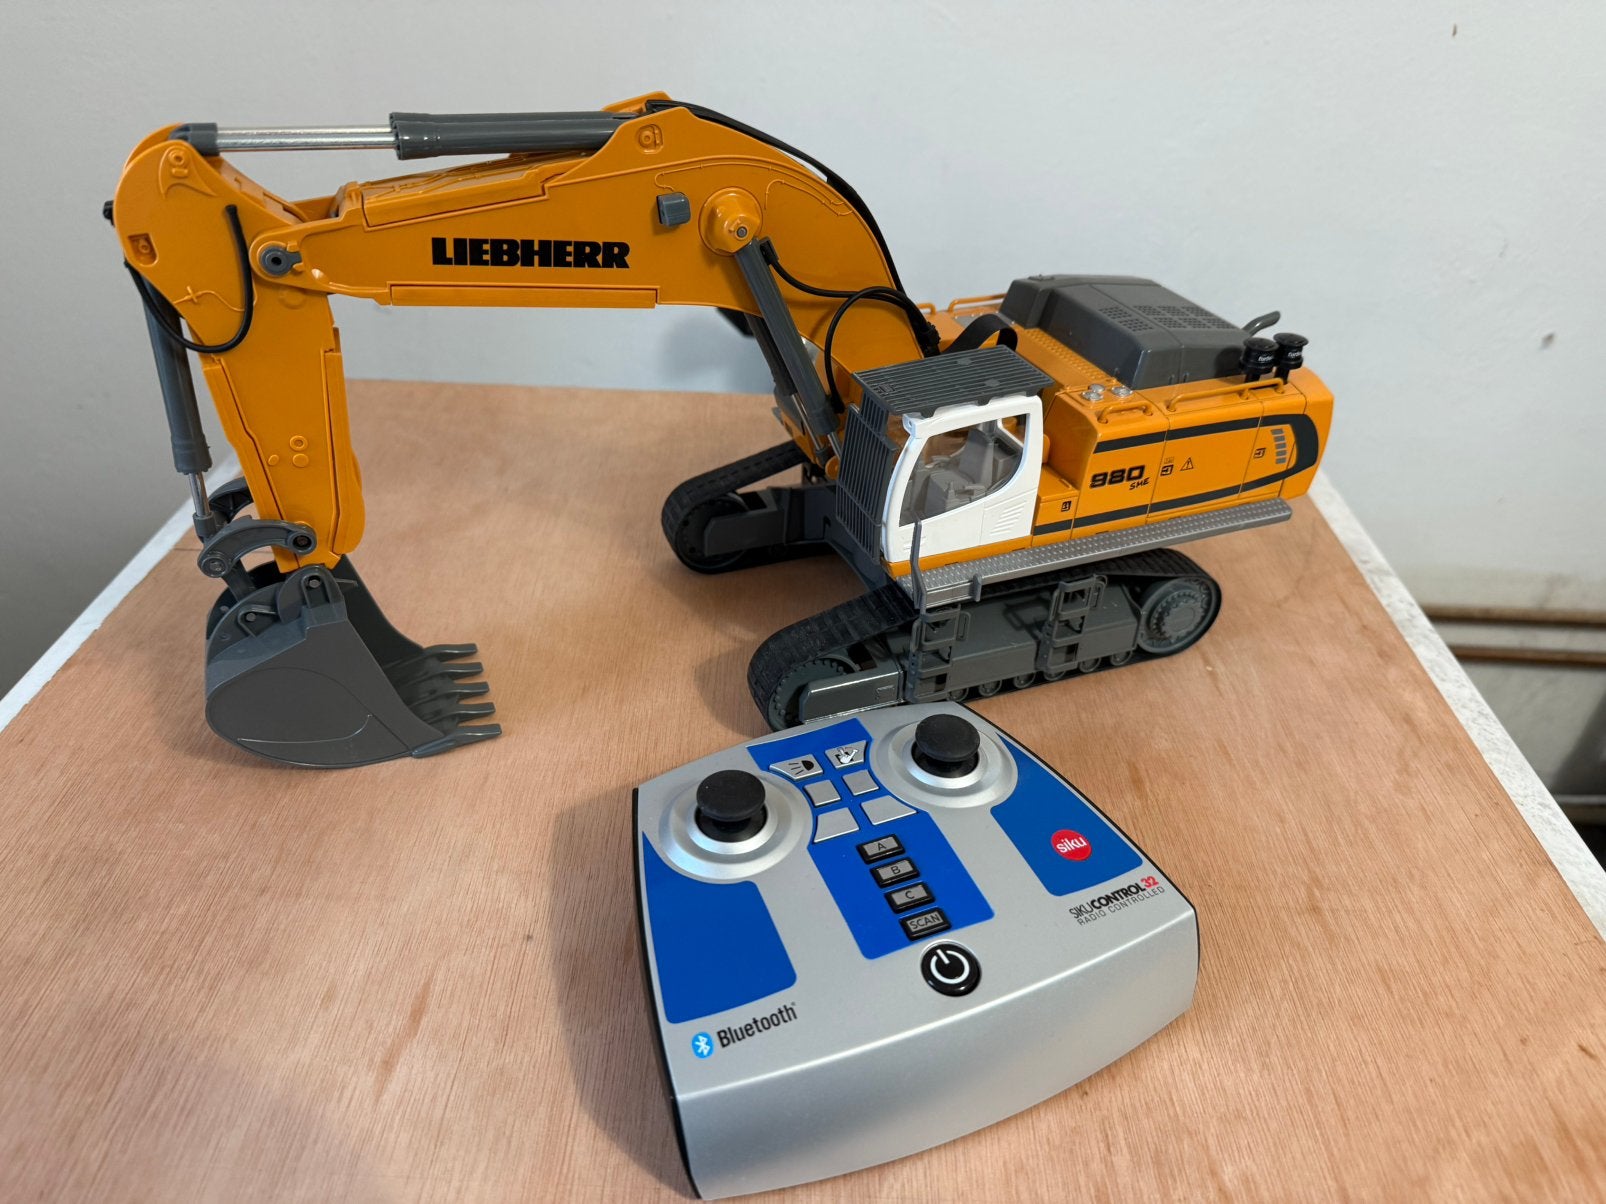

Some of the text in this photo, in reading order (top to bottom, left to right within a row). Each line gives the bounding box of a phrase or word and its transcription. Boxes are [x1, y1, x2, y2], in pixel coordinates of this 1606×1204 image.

[432, 237, 630, 269] LIEBHERR
[1089, 464, 1146, 489] 980
[1129, 477, 1150, 490] SME
[877, 842, 887, 851] A
[1056, 837, 1087, 853] siku
[890, 865, 901, 874] B
[905, 890, 915, 900] C
[1076, 886, 1165, 926] RADIO CONTROLLED
[909, 913, 941, 930] SCAN
